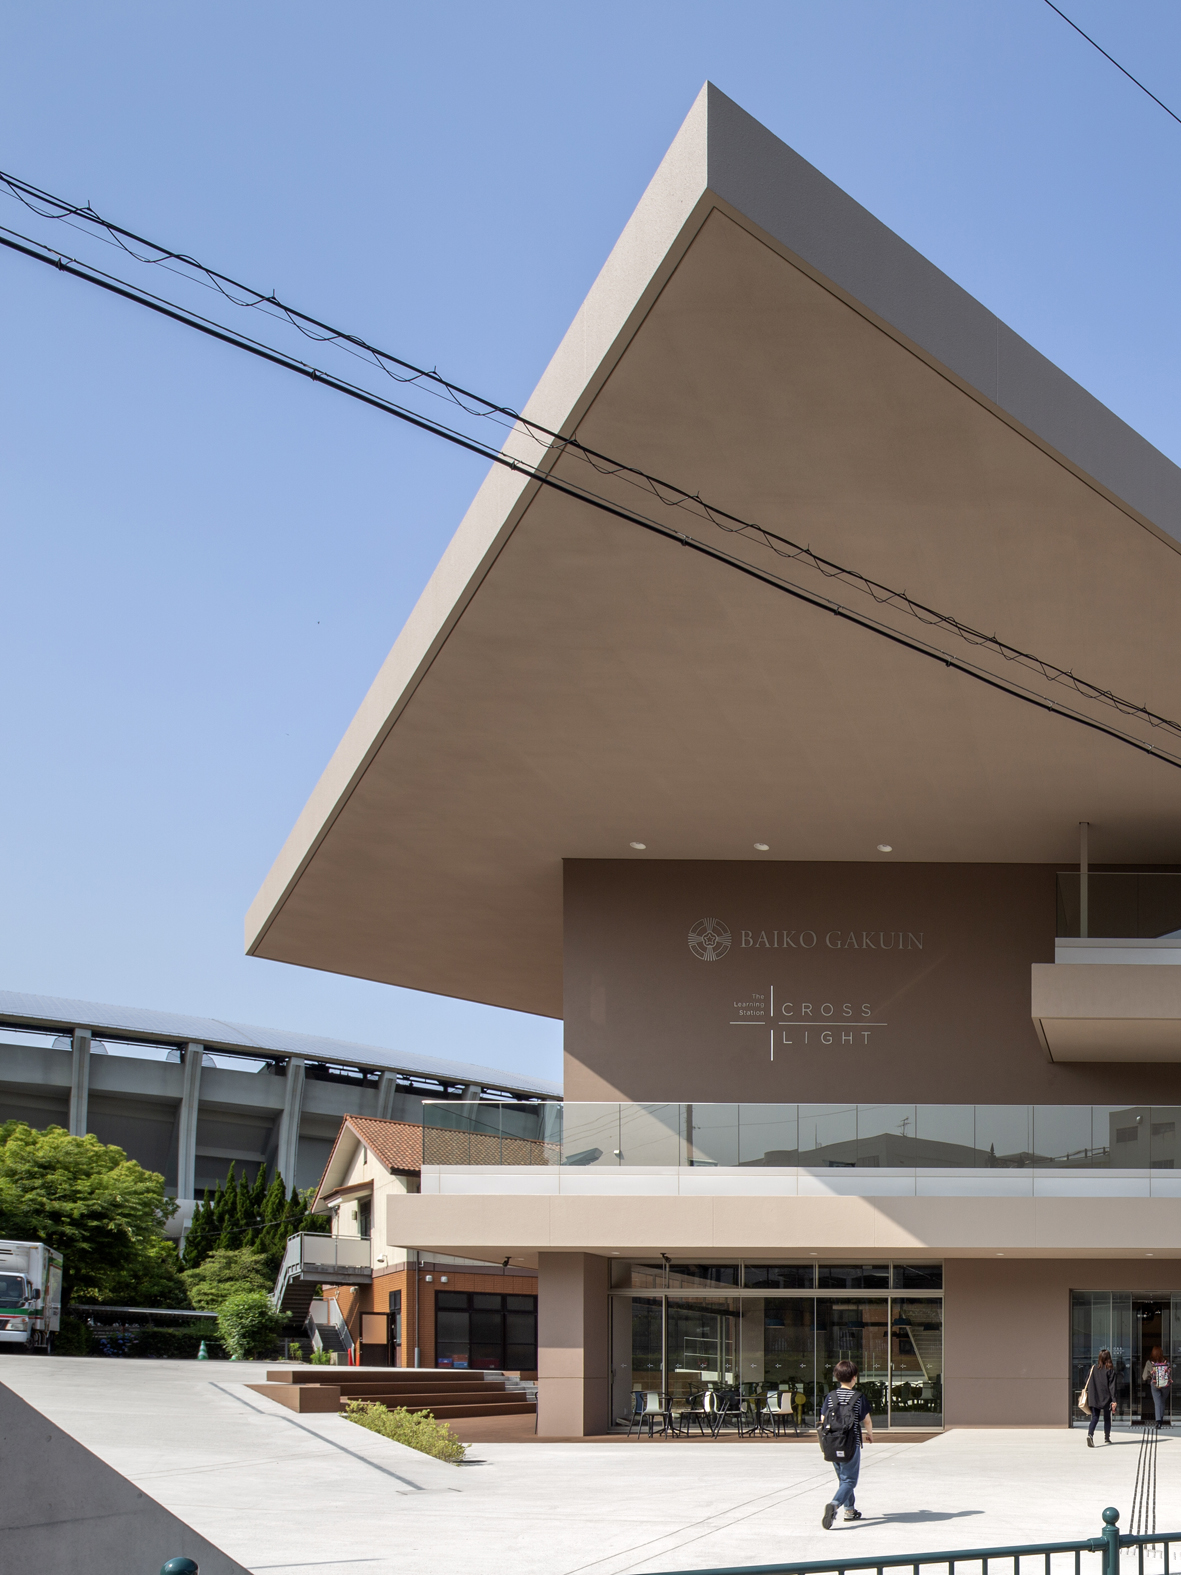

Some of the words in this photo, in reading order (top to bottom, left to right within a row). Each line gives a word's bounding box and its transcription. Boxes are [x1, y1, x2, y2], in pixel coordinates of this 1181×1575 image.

[740, 930, 817, 948] BAIKO
[825, 931, 923, 949] GAKUIN
[733, 1001, 765, 1009] Learning
[782, 1003, 872, 1017] CROSS
[783, 1031, 872, 1045] LIGHT
